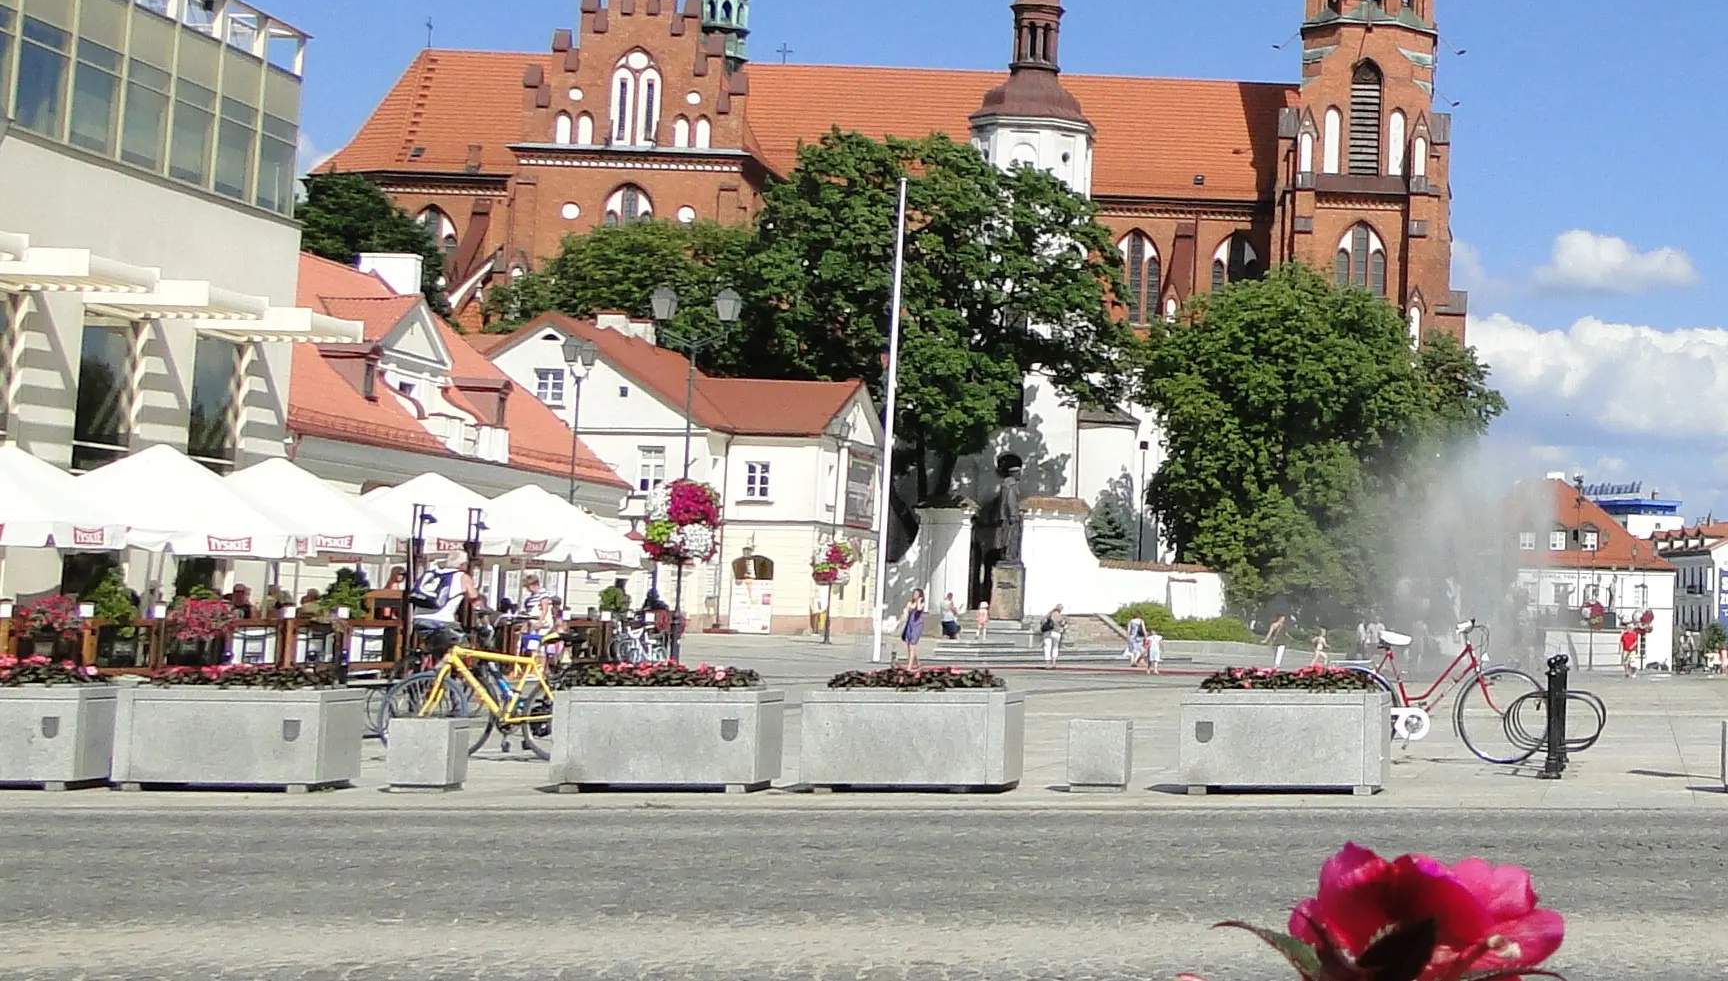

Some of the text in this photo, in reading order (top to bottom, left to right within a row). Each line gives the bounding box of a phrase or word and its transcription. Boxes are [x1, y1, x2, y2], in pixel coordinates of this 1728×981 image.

[76, 529, 103, 544] TYSKIE
[316, 535, 352, 548] TYSKIE
[209, 537, 250, 551] TYSKIE
[439, 539, 465, 551] TYSK
